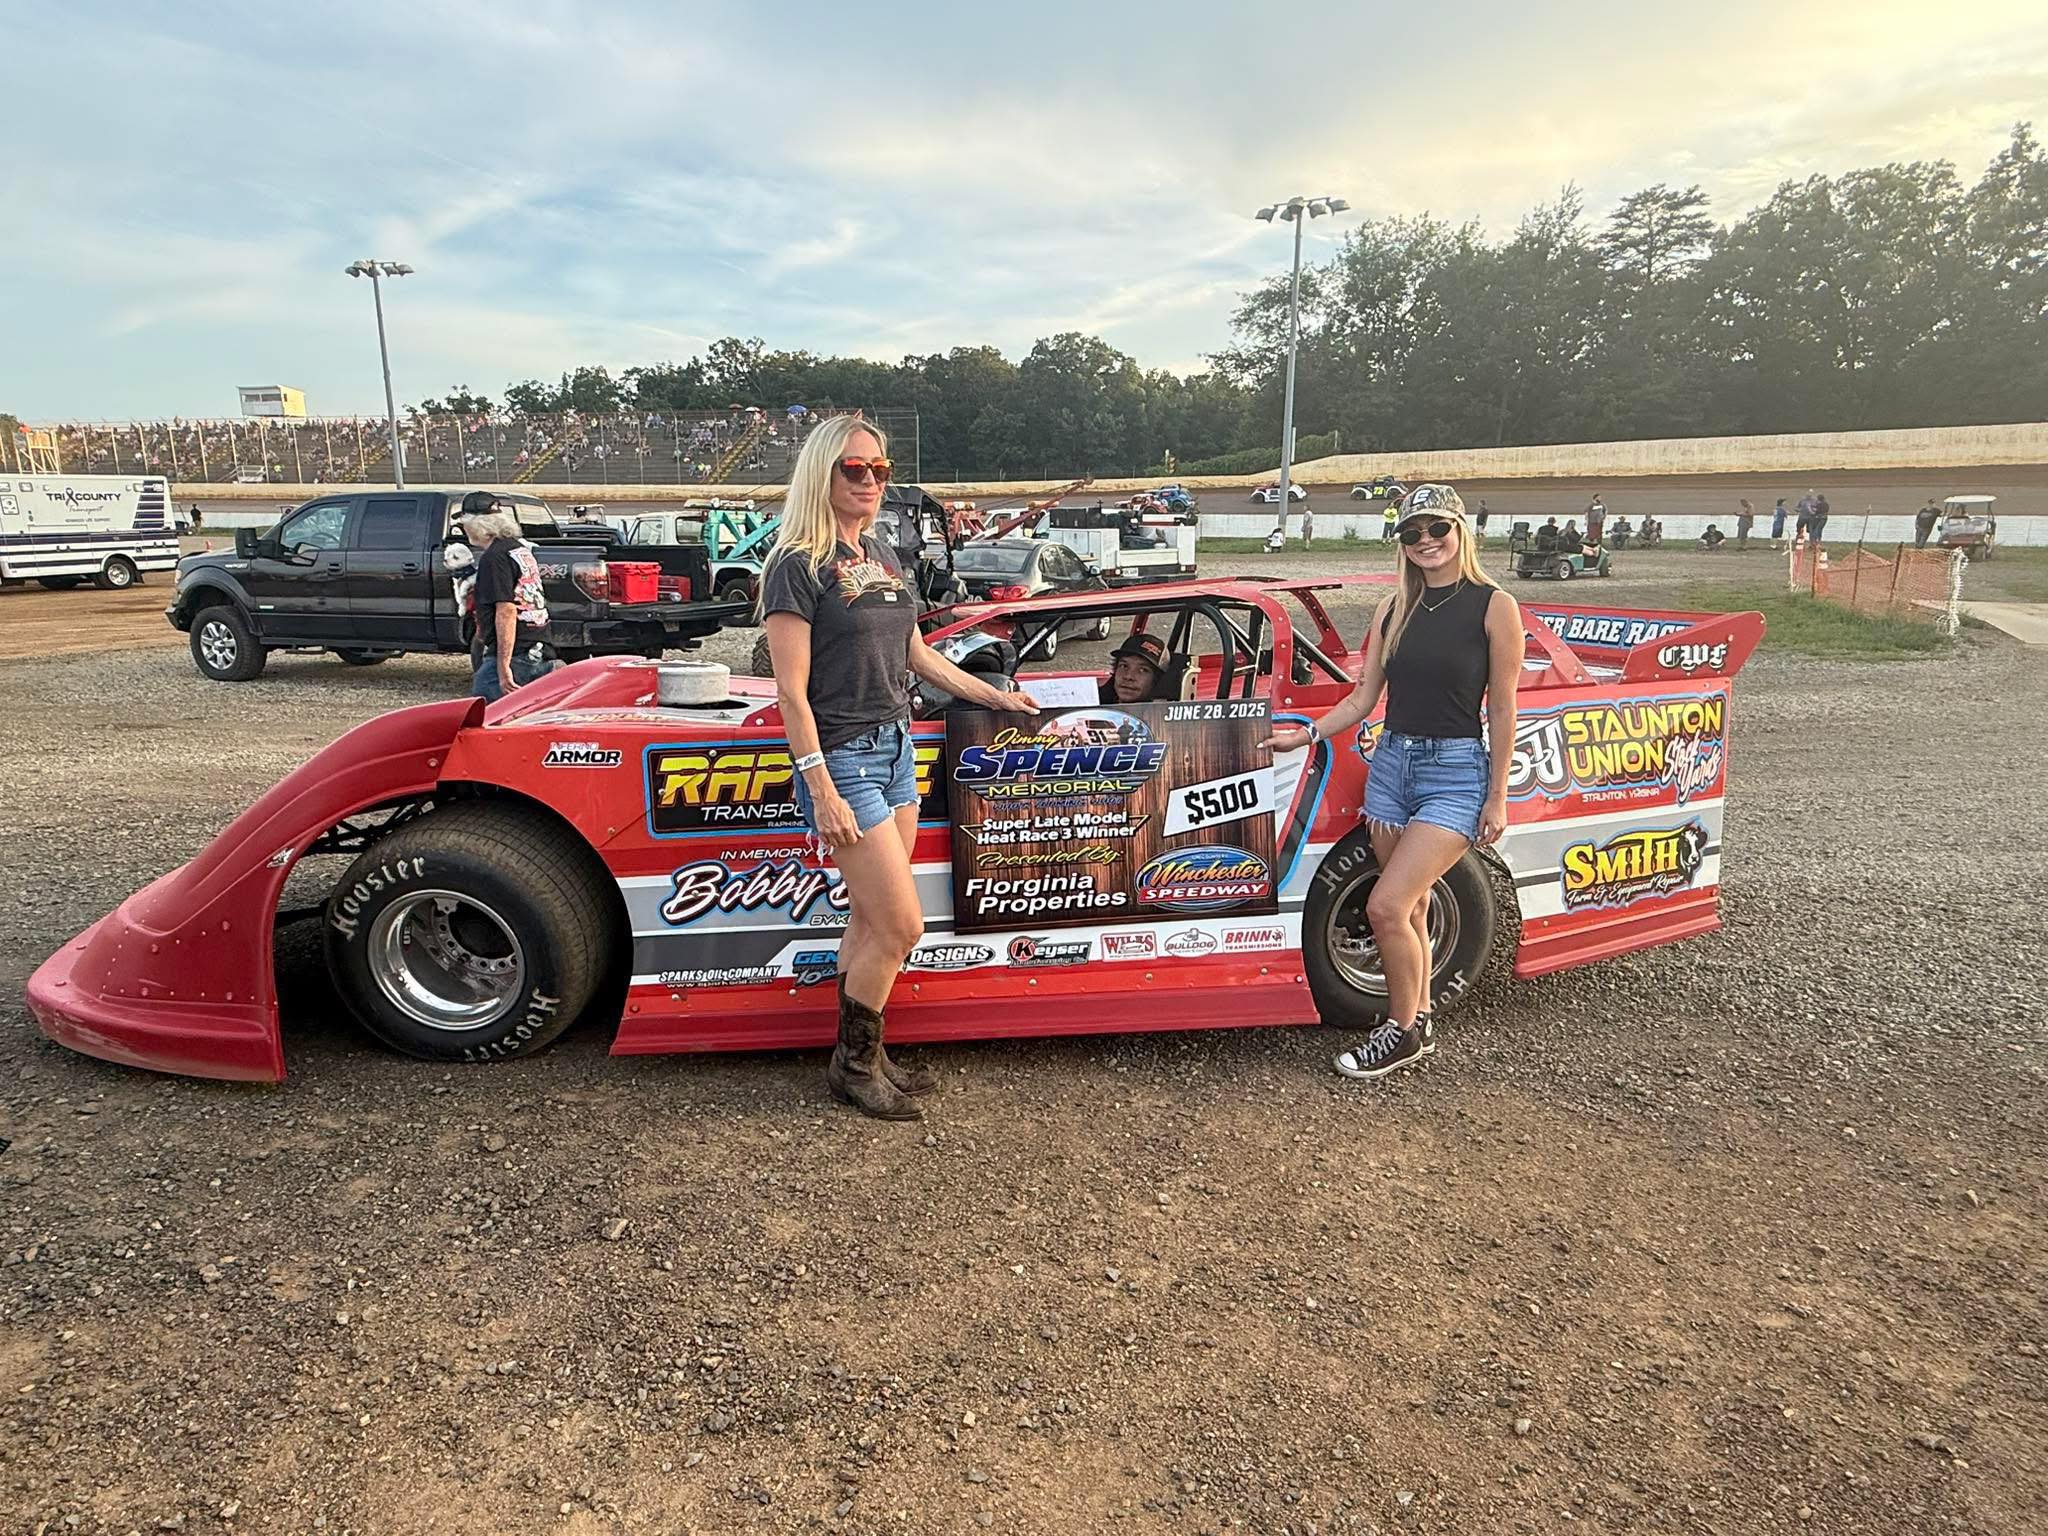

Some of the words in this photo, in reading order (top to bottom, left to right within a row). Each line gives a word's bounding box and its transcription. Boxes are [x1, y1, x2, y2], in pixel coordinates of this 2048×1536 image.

[75, 493, 121, 501] COUNTY
[1567, 616, 1626, 643] BARE
[1164, 705, 1202, 721] JUNE
[1228, 702, 1266, 718] 2025
[1563, 701, 1723, 744] STAUNTON
[986, 727, 1061, 753] Jimmy
[544, 750, 621, 763] ARMOR
[954, 743, 1166, 782] SPENCE
[1569, 739, 1664, 778] UNION
[1678, 744, 1722, 802] Yards
[988, 779, 1134, 798] MEMORIAL
[1184, 778, 1258, 825] $500
[982, 818, 1030, 834] Super
[1034, 815, 1070, 829] Late
[1073, 811, 1127, 827] Model
[977, 831, 1017, 845] Heat
[1019, 830, 1059, 843] Race
[1062, 828, 1072, 841] 3
[1076, 826, 1136, 839] Winner
[720, 850, 737, 860] IN
[740, 847, 814, 860] MEMORY
[976, 846, 1087, 867] Presented
[1564, 825, 1686, 890] SMITH
[966, 872, 1094, 897] Florginia
[1141, 859, 1267, 888] Winchester
[330, 855, 425, 942] Hoosier
[663, 863, 827, 921] Bobby
[978, 889, 1127, 916] Properties
[1145, 883, 1266, 900] SPEEDWAY
[811, 914, 835, 926] BY
[1166, 941, 1215, 950] BULLDOG
[1224, 929, 1272, 944] BRINN
[909, 946, 989, 963] DeSIGNS
[1015, 941, 1088, 959] Keyser
[660, 970, 703, 982] SPARKS
[707, 968, 724, 980] OIL
[728, 966, 780, 980] COMPANY
[465, 987, 560, 1062] Hoosier
